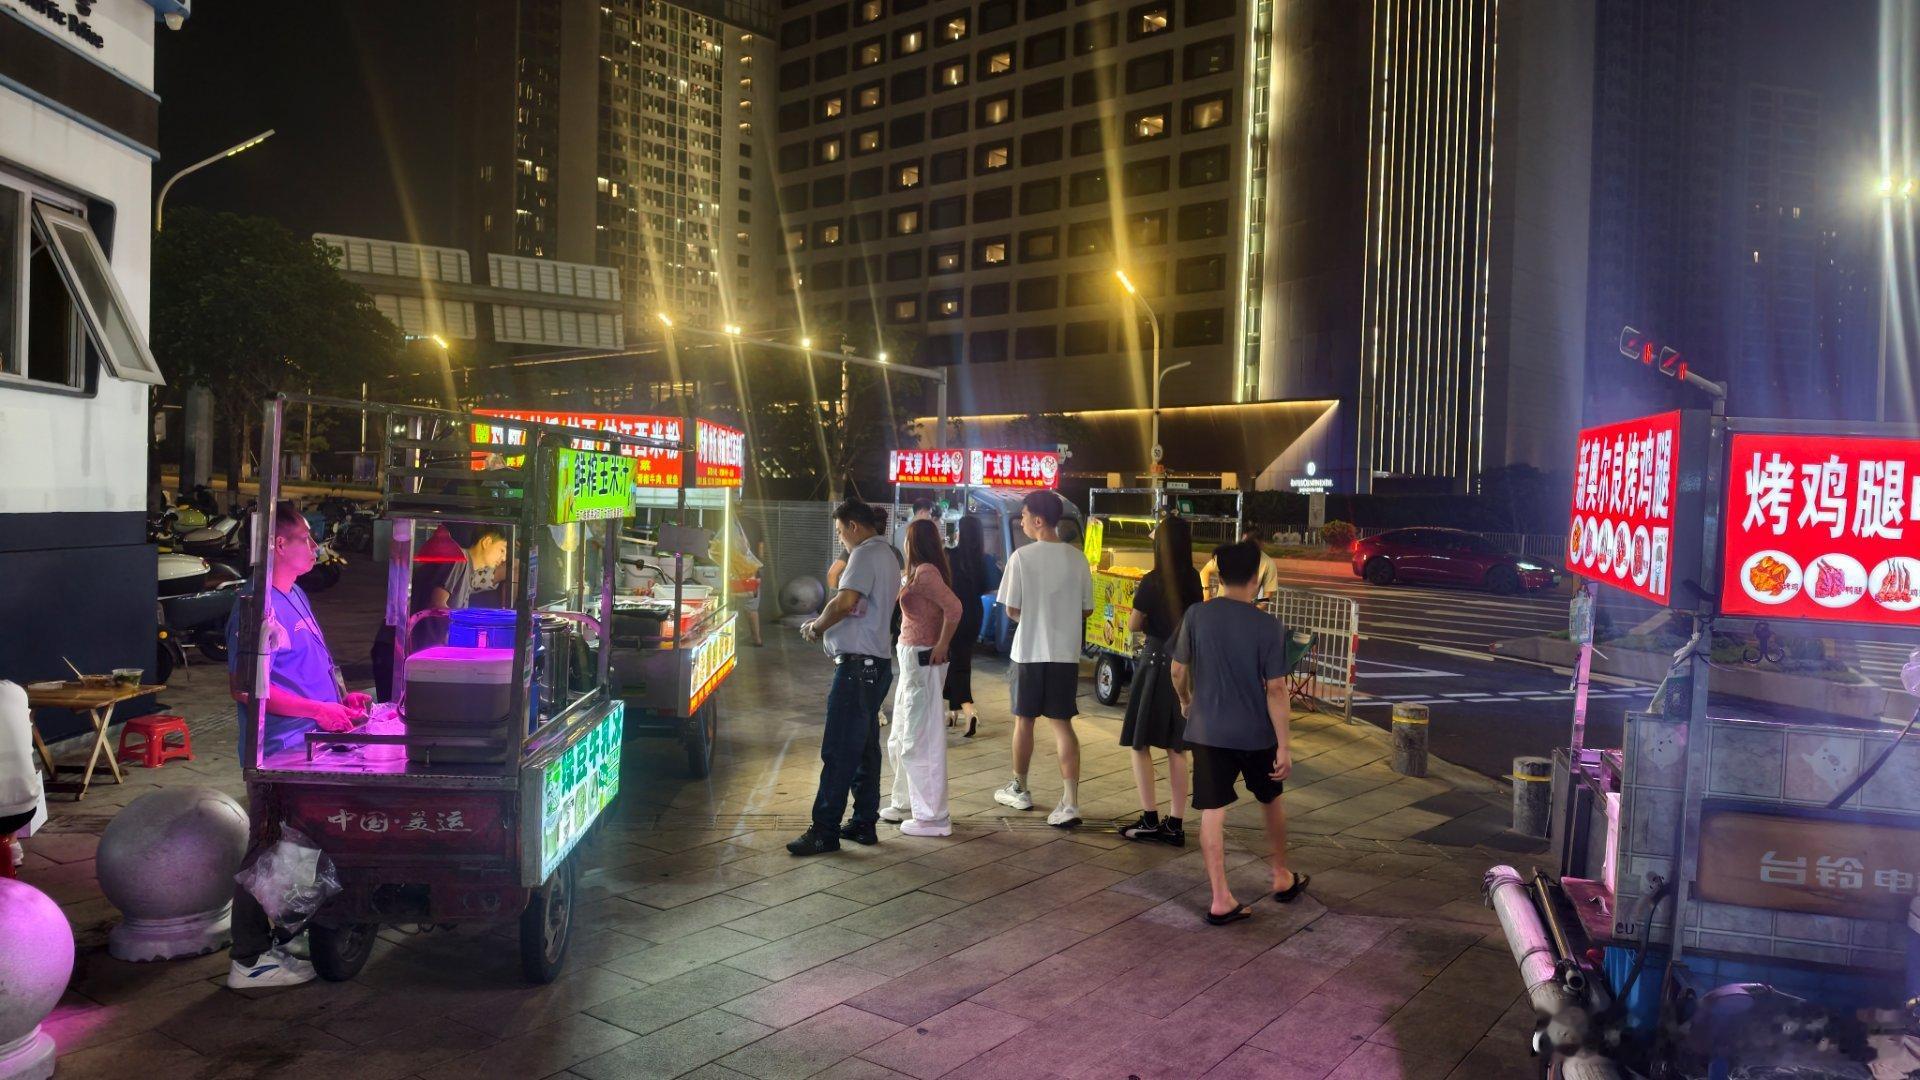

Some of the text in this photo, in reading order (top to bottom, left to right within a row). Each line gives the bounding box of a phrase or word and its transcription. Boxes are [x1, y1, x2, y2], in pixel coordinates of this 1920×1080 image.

[897, 451, 952, 476] 广式萝卜牛杂
[983, 453, 1042, 479] 广式萝卜牛杂
[1575, 429, 1673, 520] 新奥尔良烤鸡腿
[1741, 451, 1920, 541] 烤鸡腿
[1760, 850, 1920, 894] 台铃电
